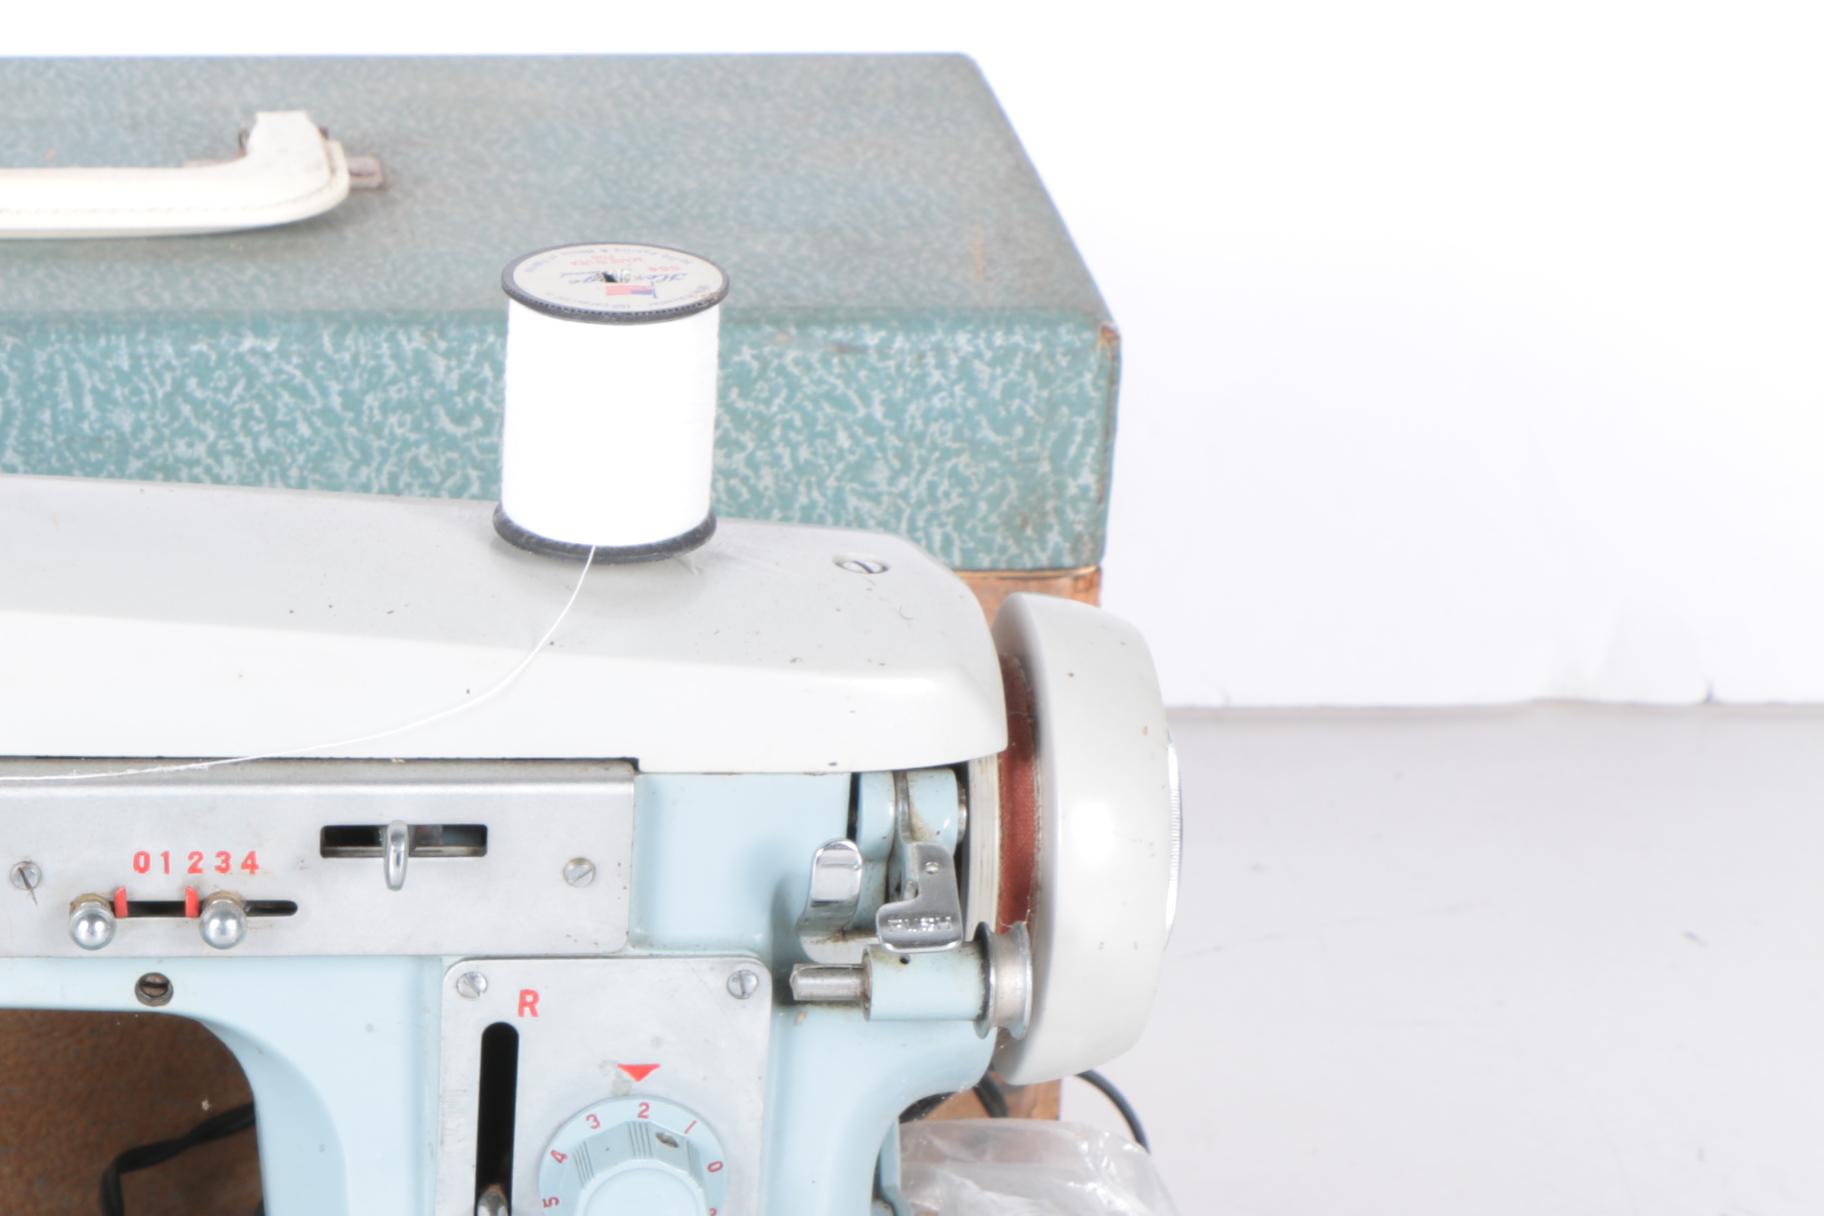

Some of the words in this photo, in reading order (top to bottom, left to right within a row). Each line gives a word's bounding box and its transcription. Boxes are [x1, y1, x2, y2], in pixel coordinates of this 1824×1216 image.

[517, 988, 541, 1018] R
[585, 1113, 601, 1129] 3
[637, 1102, 651, 1119] 2
